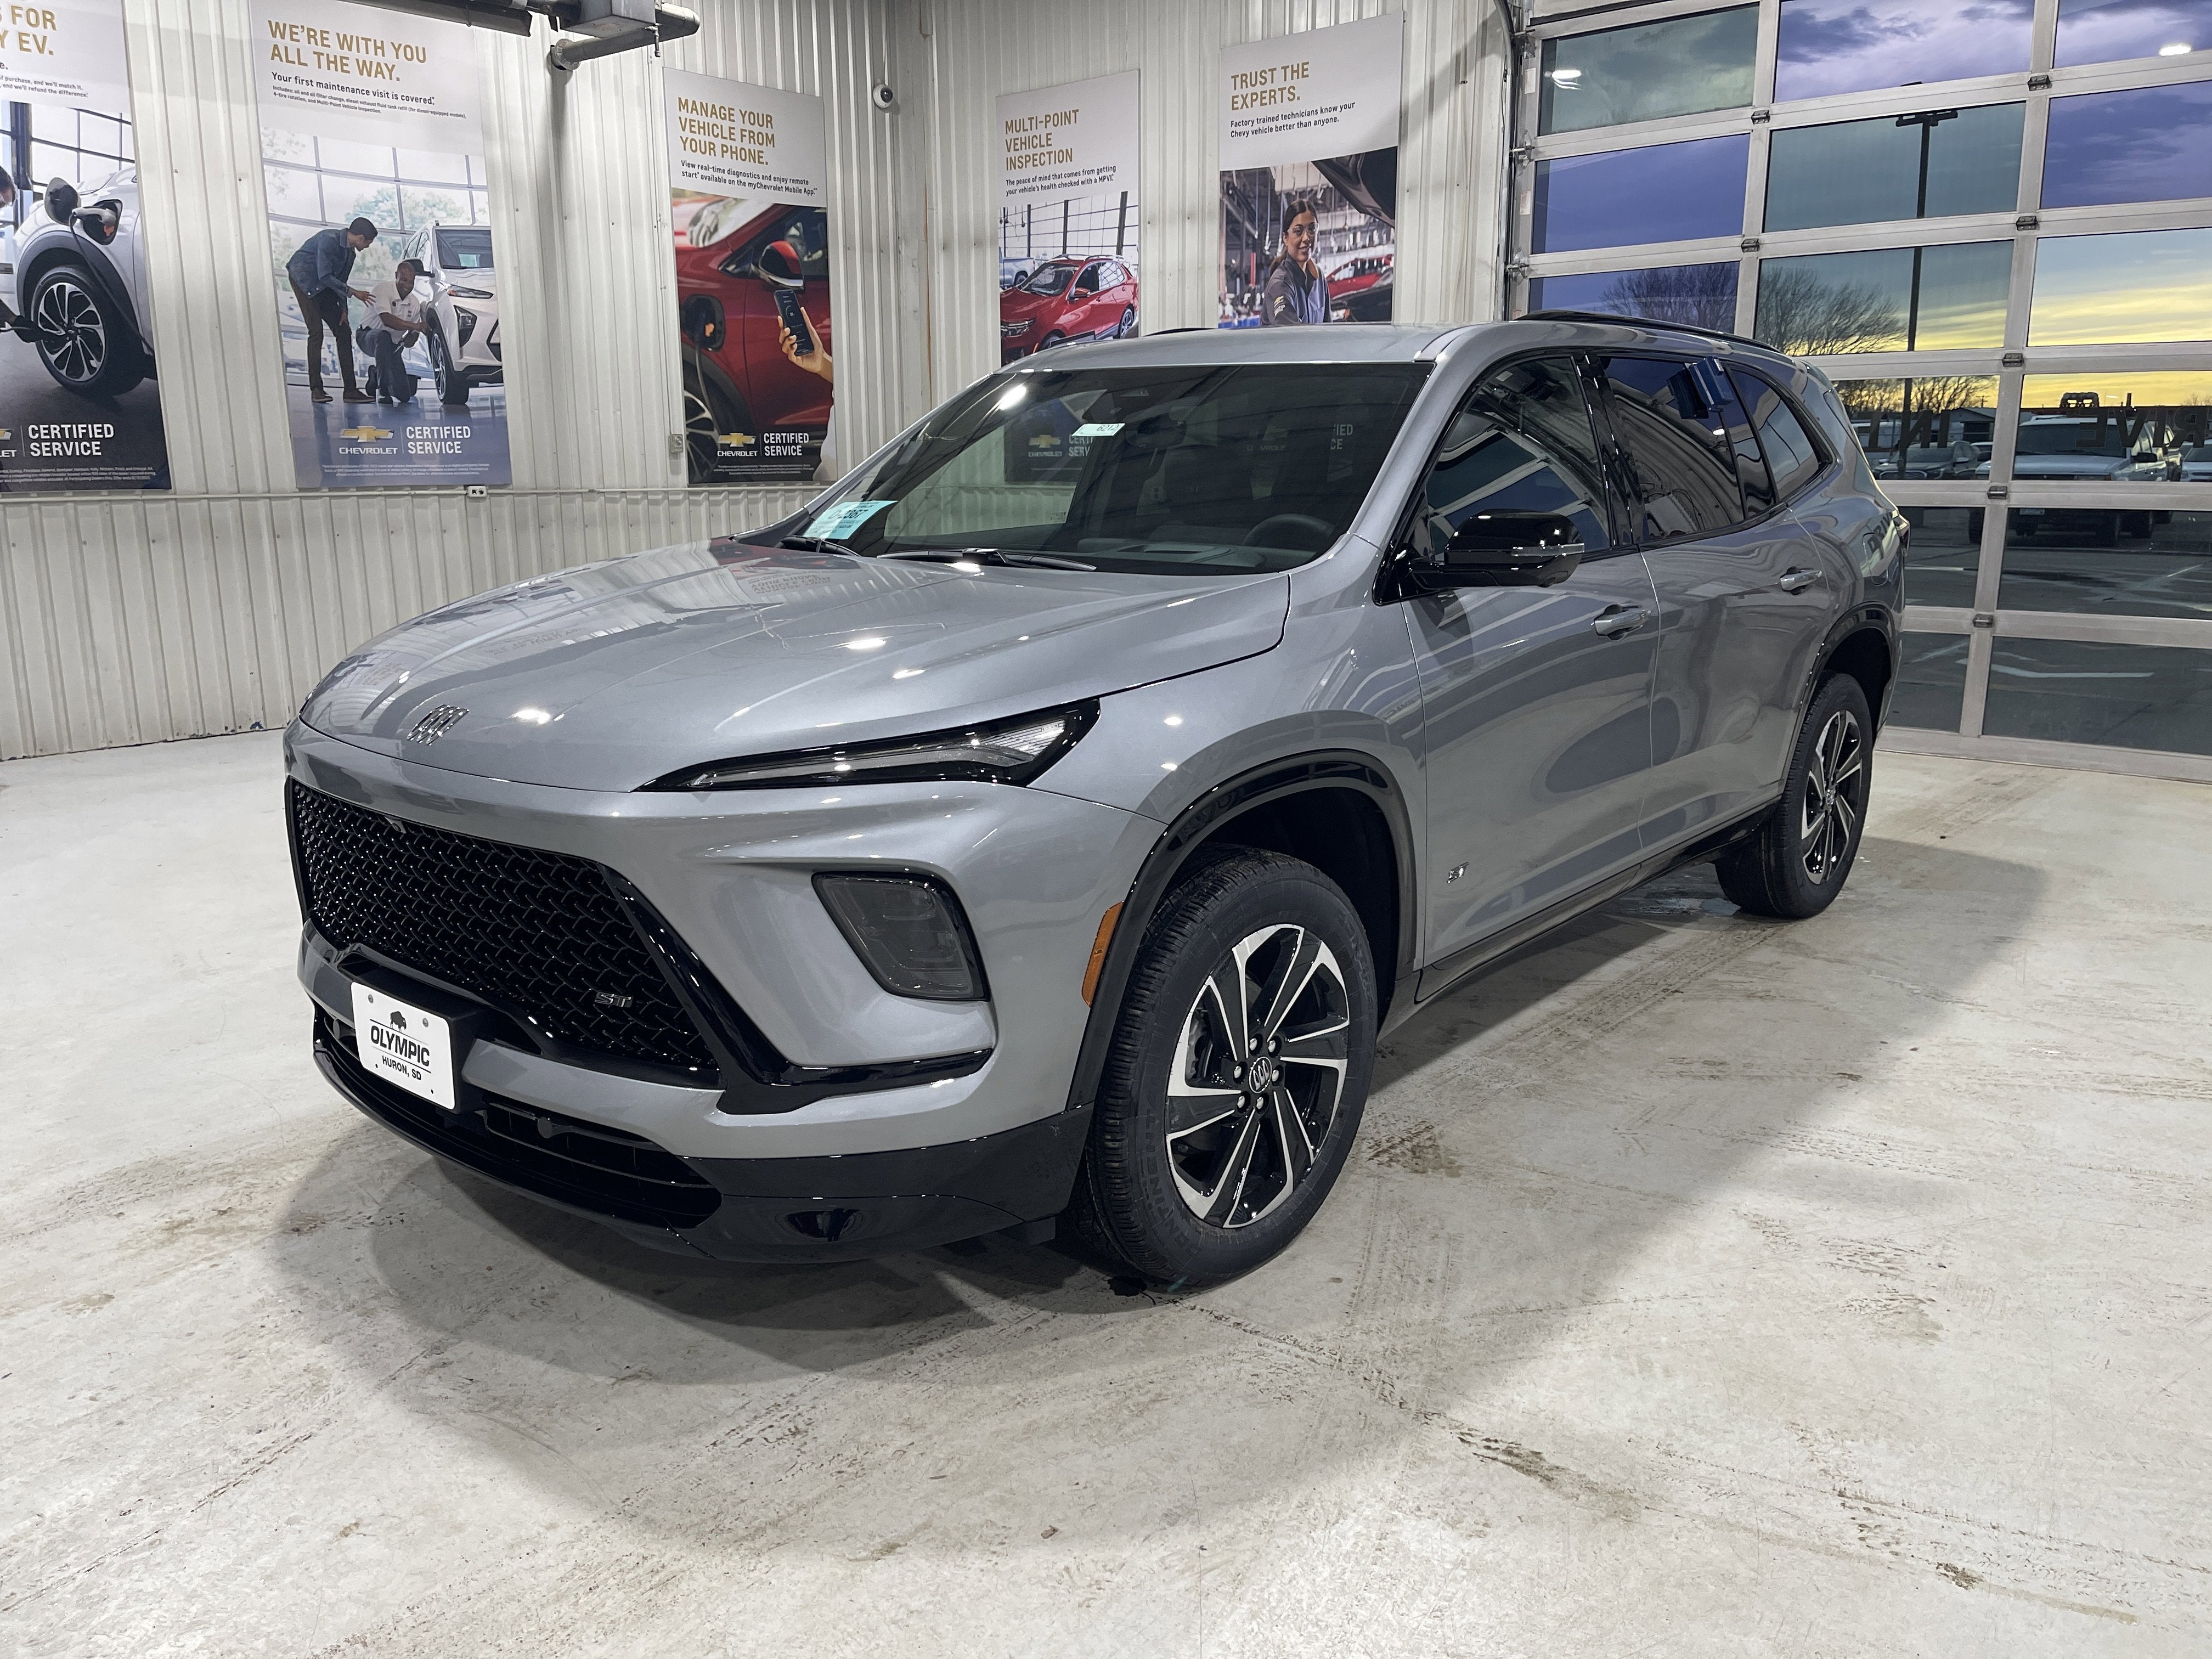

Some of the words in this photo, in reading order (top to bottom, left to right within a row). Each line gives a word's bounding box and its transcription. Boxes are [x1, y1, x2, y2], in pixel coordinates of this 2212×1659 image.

[11, 5, 57, 31] FOR
[18, 32, 54, 55] EV.
[268, 20, 331, 48] WE'RE
[336, 32, 385, 57] WITH
[390, 42, 427, 63] YOU
[270, 44, 308, 67] ALL
[313, 51, 350, 74] THE
[356, 58, 400, 81] WAY.
[272, 72, 292, 83] Your
[294, 76, 314, 87] first
[316, 81, 370, 95] maintenance
[372, 89, 390, 99] visit
[392, 92, 398, 100] is
[1231, 68, 1277, 91] TRUST
[1281, 61, 1310, 82] THE
[1231, 86, 1300, 110] EXPERTS.
[678, 97, 736, 122] MANAGE
[739, 109, 774, 129] YOUR
[1005, 109, 1079, 134] MULTI-POINT
[1231, 118, 1255, 128] Factory
[1256, 114, 1279, 125] trained
[1281, 109, 1318, 121] technicians
[1320, 105, 1338, 114] know
[1339, 102, 1356, 112] your
[679, 116, 736, 142] VEHICLE
[741, 128, 775, 148] FROM
[1231, 129, 1250, 138] Chevy
[1251, 126, 1273, 136] vehicle
[1275, 122, 1295, 132] better
[1297, 120, 1312, 129] than
[1313, 116, 1340, 127] anyone.
[680, 136, 716, 157] YOUR
[721, 144, 769, 165] PHONE.
[1005, 133, 1052, 153] VEHICLE
[1006, 148, 1073, 171] INSPECTION
[681, 160, 696, 169] View
[697, 163, 725, 174] real-time
[727, 168, 760, 180] diagnostics
[761, 173, 771, 181] and
[773, 176, 788, 185] enjoy
[789, 177, 809, 185] remote
[701, 172, 727, 184] available
[737, 179, 747, 187] the
[748, 182, 783, 192] myChevrolet
[785, 185, 802, 195] Mobile
[1016, 178, 1030, 187] peace
[1038, 173, 1051, 182] mind
[1082, 168, 1095, 176] from
[1096, 166, 1116, 176] getting
[1018, 184, 1040, 194] vehicle's
[1041, 182, 1057, 190] health
[1058, 179, 1080, 189] checked
[1081, 178, 1093, 186] with
[28, 424, 114, 439] CERTIFIED
[406, 426, 471, 439] CERTIFIED
[763, 432, 809, 444] CERTIFIED
[30, 441, 102, 456] SERVICE
[408, 441, 462, 454] SERVICE
[764, 445, 803, 456] SERVICE
[1069, 446, 1091, 457] SERV
[594, 992, 631, 1007] ST
[370, 1025, 430, 1067] OLYMPIC
[382, 1055, 409, 1077] HURON,
[411, 1069, 421, 1081] SD
